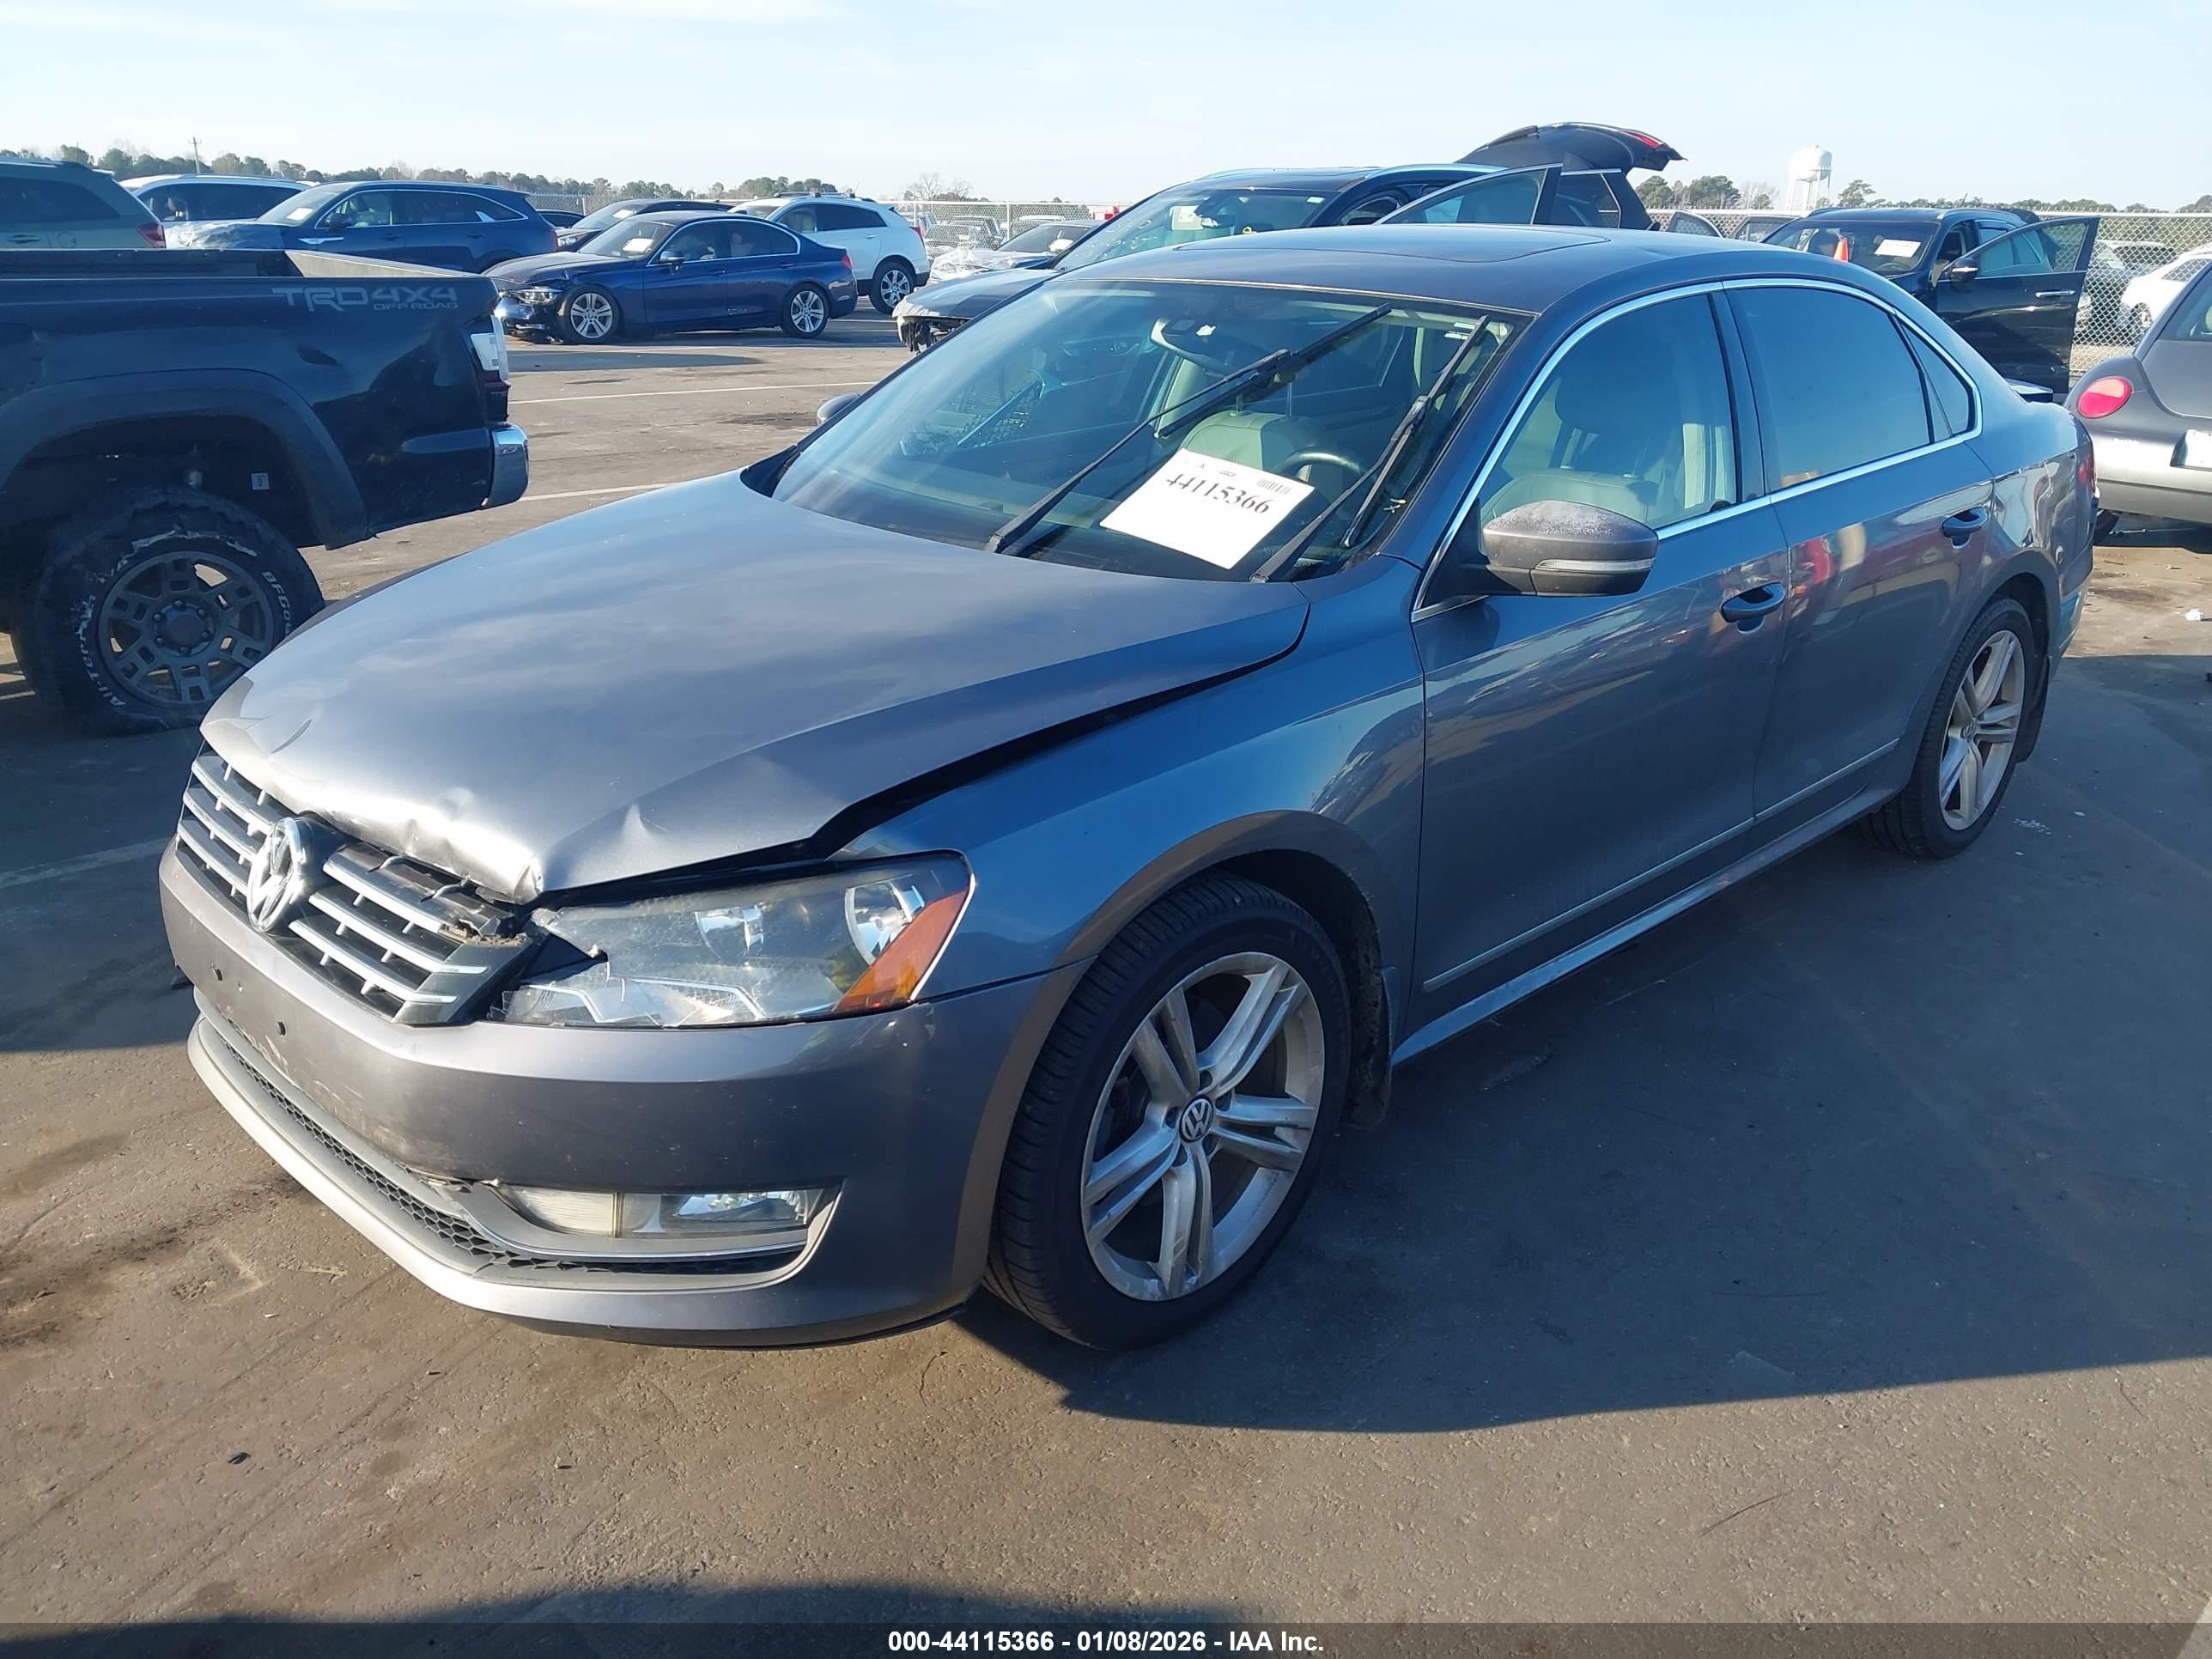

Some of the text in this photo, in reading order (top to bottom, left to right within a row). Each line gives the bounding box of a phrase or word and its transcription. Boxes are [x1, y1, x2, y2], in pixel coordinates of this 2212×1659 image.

[271, 287, 458, 312] TRD 4X4
[1166, 473, 1275, 514] 44115366
[1182, 1098, 1213, 1140] VW
